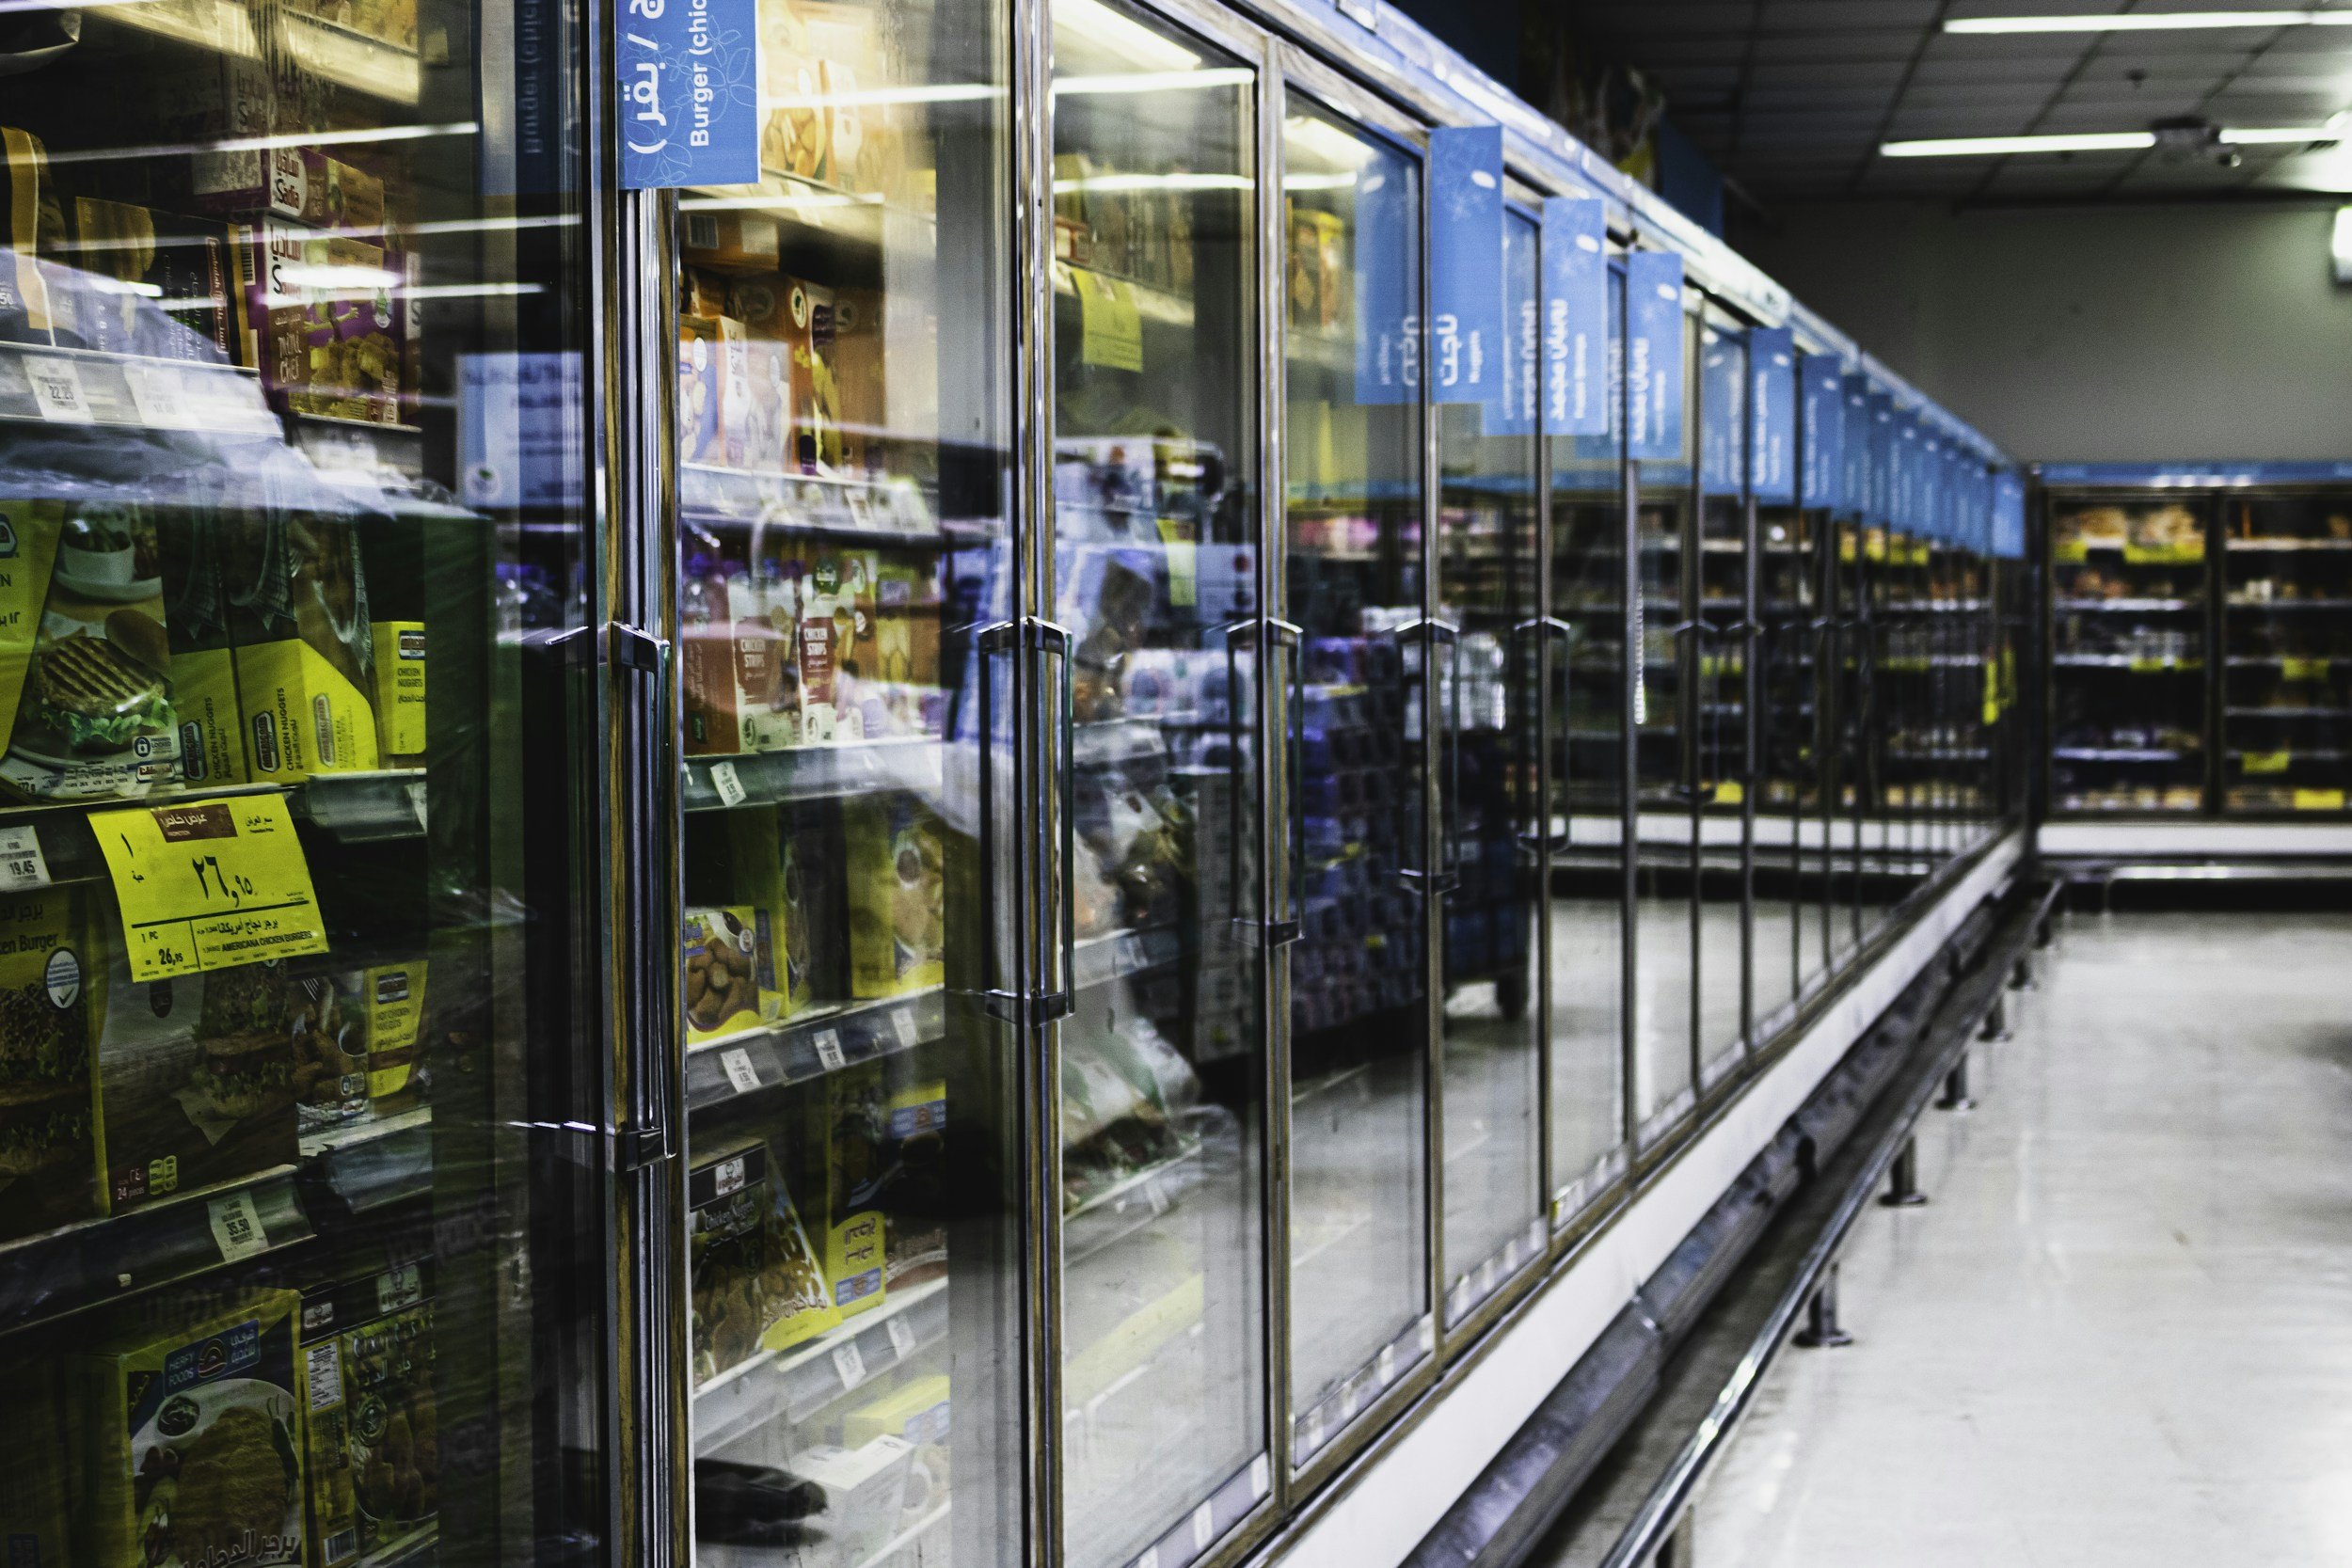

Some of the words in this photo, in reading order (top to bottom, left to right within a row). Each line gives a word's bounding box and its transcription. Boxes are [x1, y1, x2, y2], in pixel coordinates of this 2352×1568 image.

[624, 63, 667, 127] بقر
[690, 62, 713, 147] Burger
[204, 697, 216, 739] NUGGETS
[277, 688, 289, 730] NUGGETS
[210, 741, 222, 780] CHICKEN
[282, 732, 294, 771] CHICKEN
[9, 860, 36, 875] 19.45
[19, 933, 58, 953] Burger
[221, 940, 260, 952] AMERICANA
[259, 936, 284, 946] CHICKEN
[117, 1187, 128, 1201] 24
